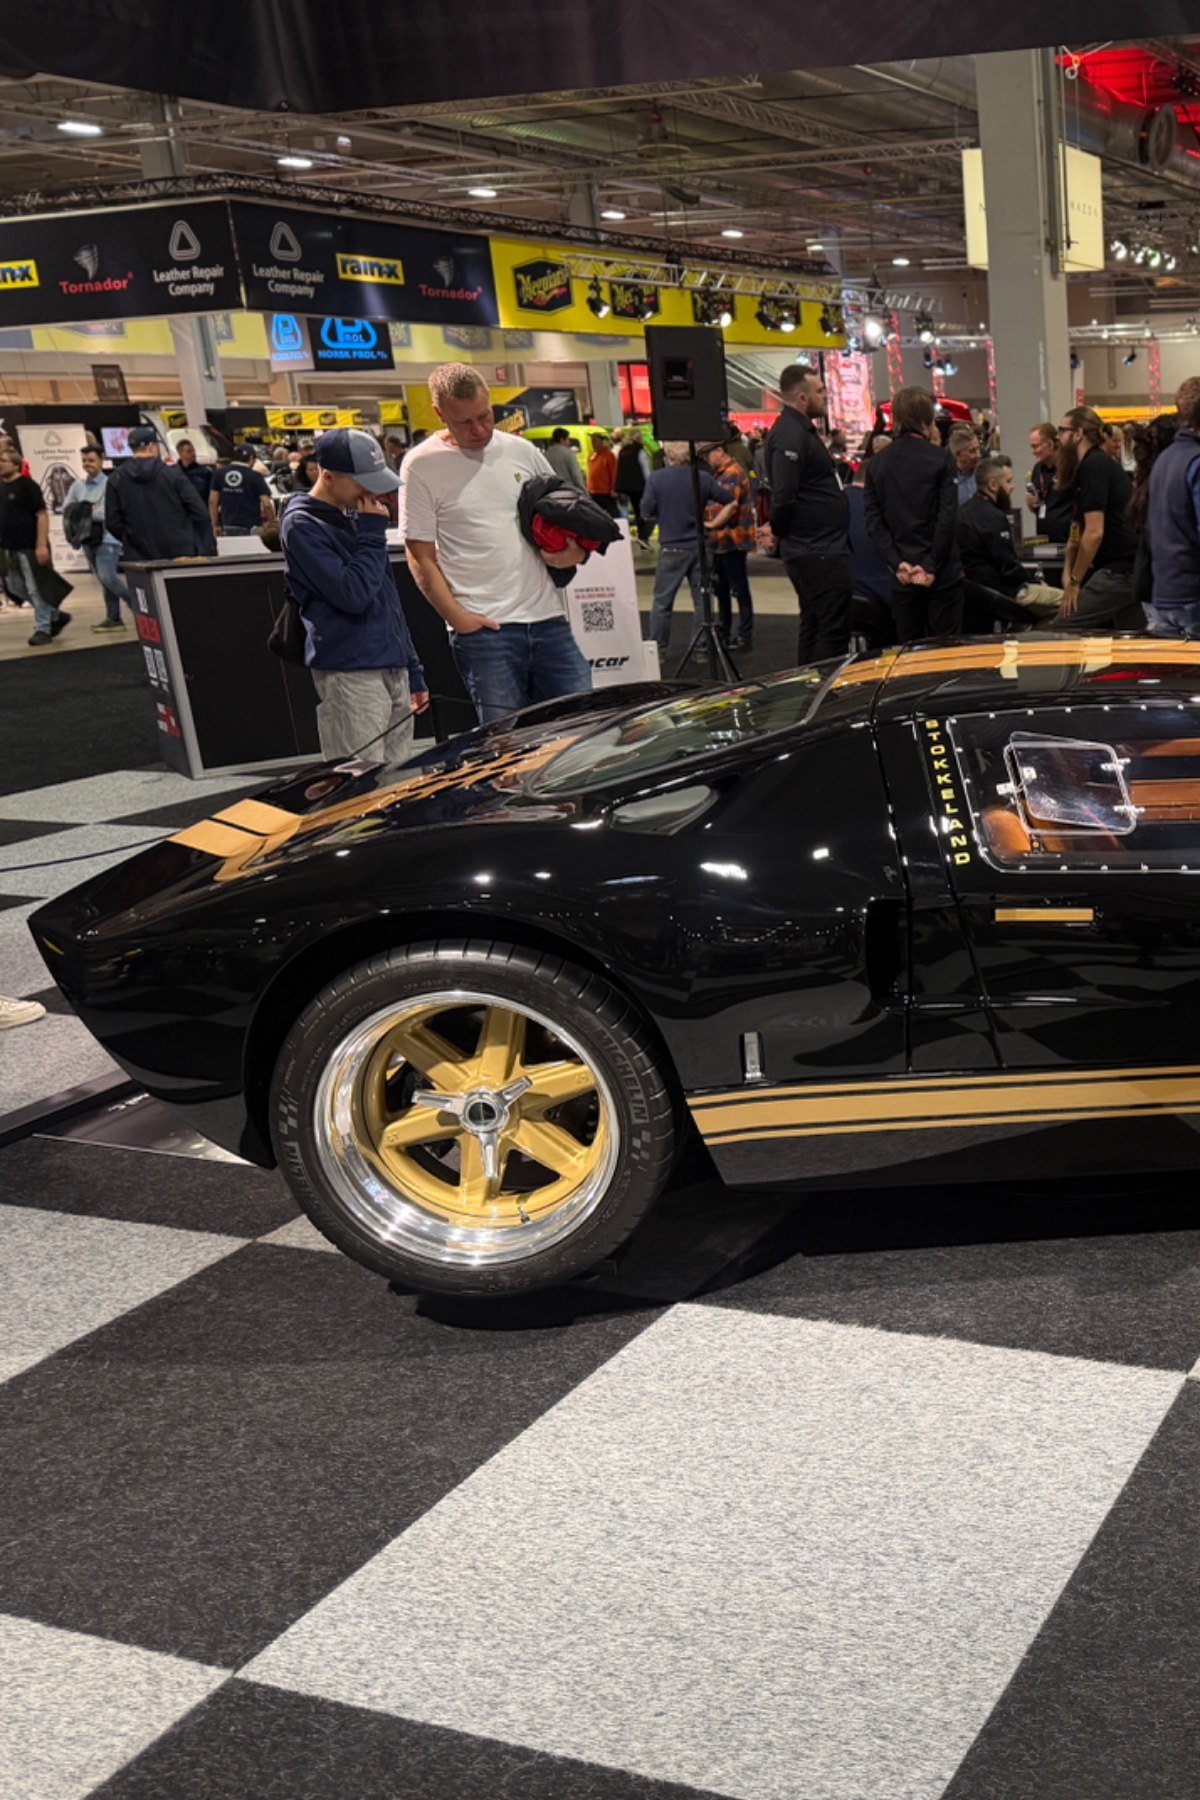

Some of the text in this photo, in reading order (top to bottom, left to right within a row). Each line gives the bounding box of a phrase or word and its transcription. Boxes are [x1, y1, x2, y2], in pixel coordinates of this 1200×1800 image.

[153, 264, 224, 283] Leather Repair
[252, 264, 324, 284] Leather Repair
[168, 281, 215, 297] Company
[268, 280, 315, 299] Company
[925, 718, 971, 866] STOKKELAND
